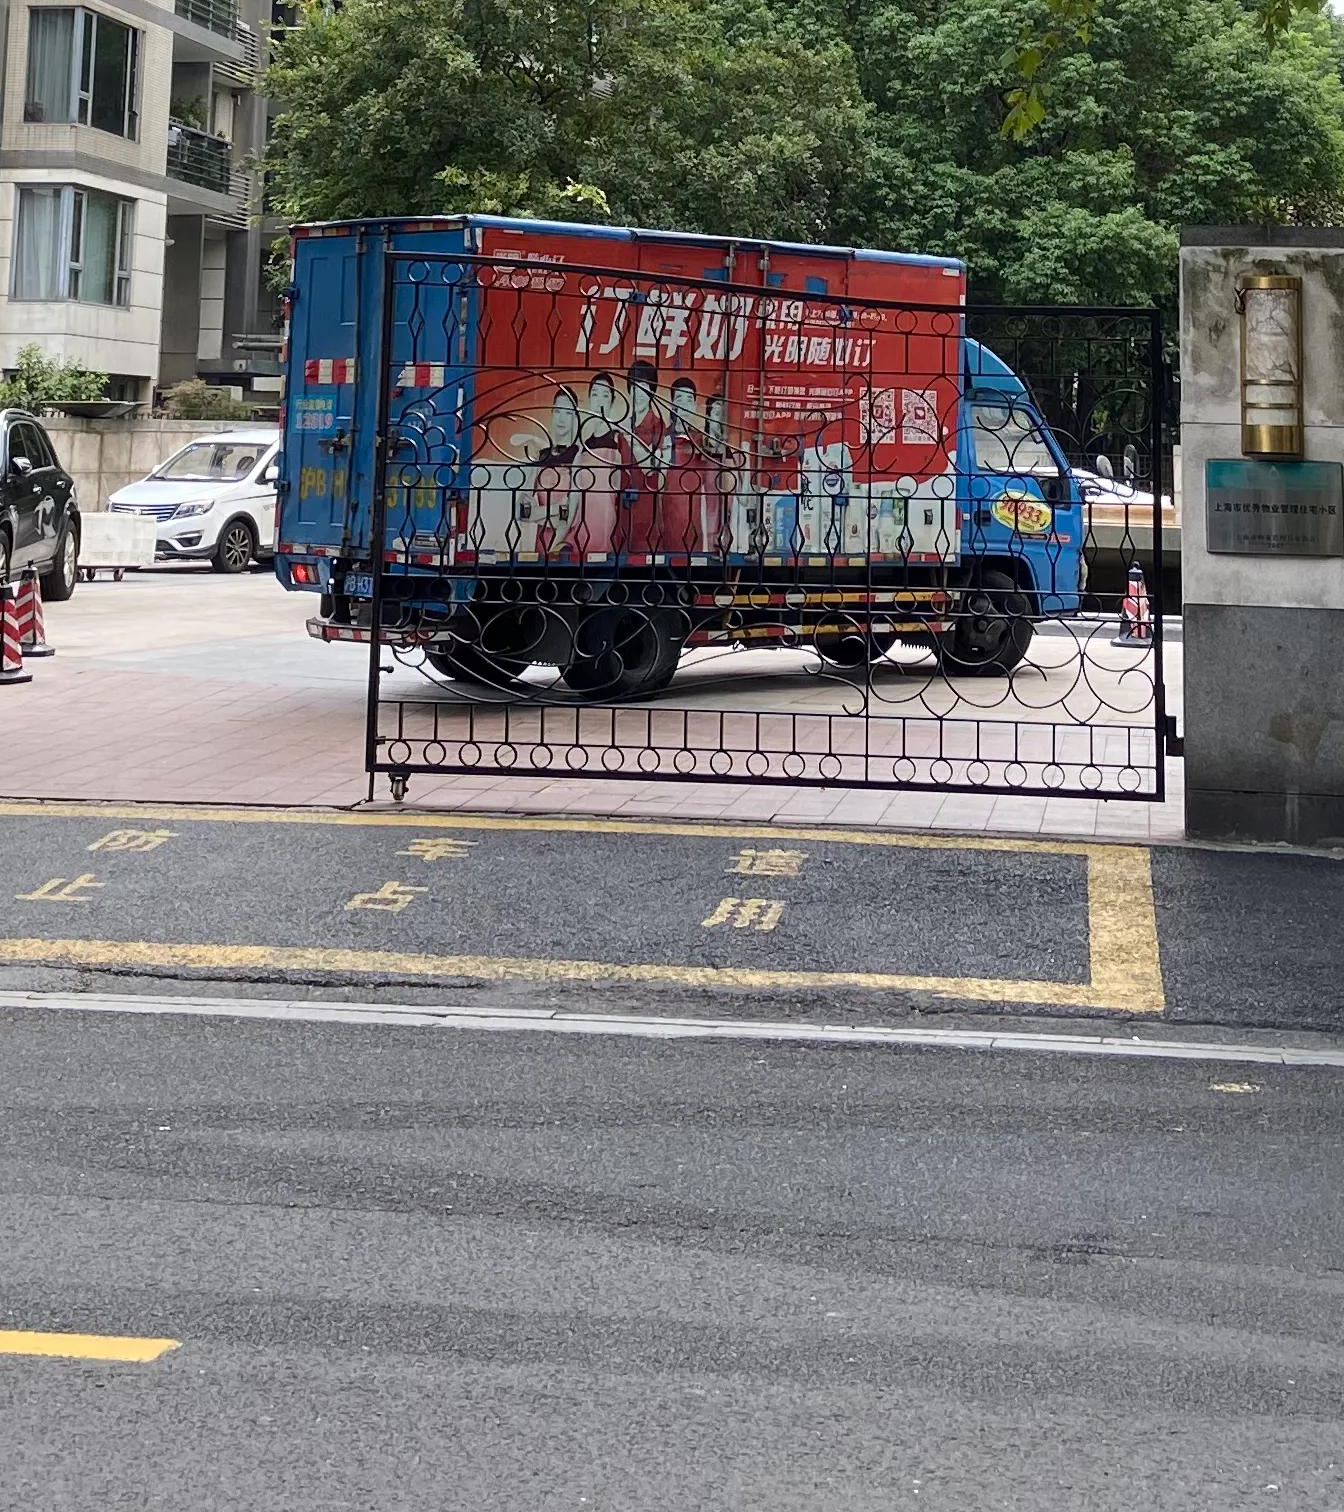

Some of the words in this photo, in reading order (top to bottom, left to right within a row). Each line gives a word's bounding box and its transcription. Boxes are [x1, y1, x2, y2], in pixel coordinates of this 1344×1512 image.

[575, 285, 755, 361] 订鲜奶
[764, 334, 876, 367] 光明随心订
